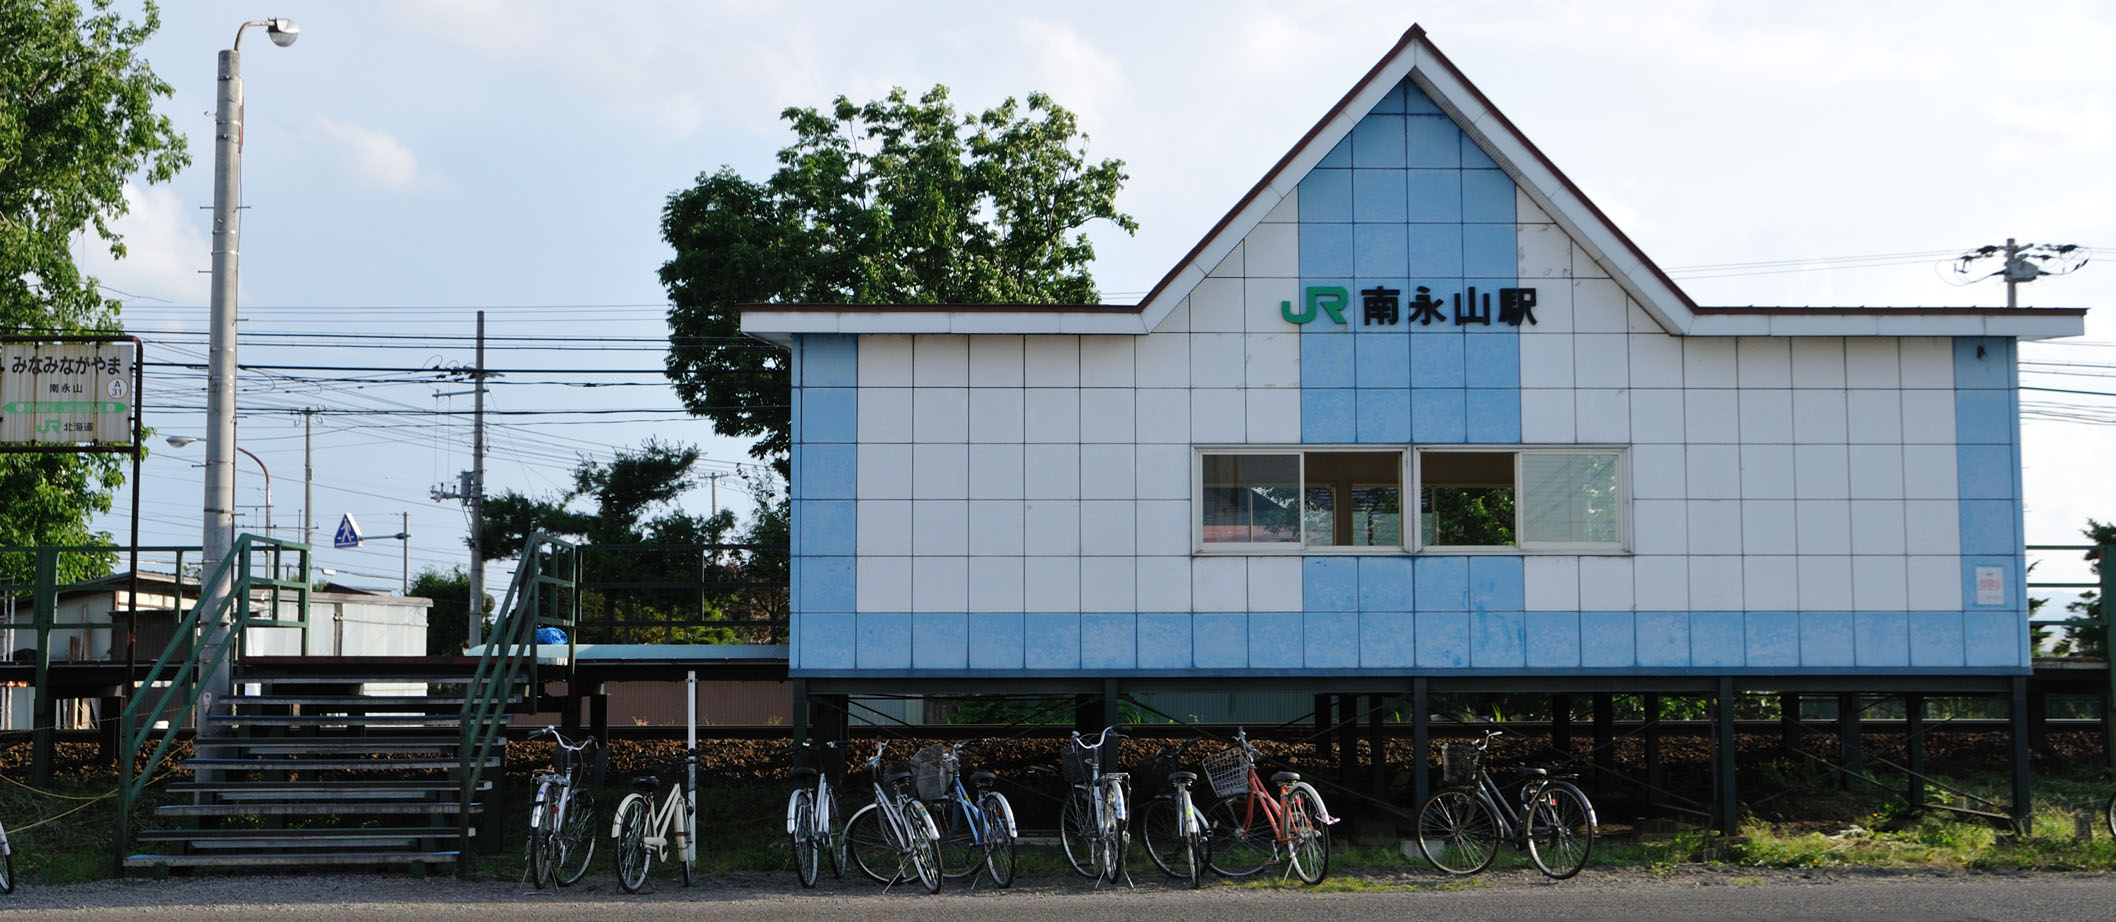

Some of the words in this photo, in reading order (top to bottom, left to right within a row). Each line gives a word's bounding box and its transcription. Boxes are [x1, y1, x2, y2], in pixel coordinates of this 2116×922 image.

[1281, 286, 1348, 324] JR
[1361, 286, 1537, 326] 南永山駅
[12, 356, 120, 375] みなみながやま
[49, 384, 82, 393] 南永山
[36, 420, 60, 434] JR
[64, 422, 93, 432] 北海道
